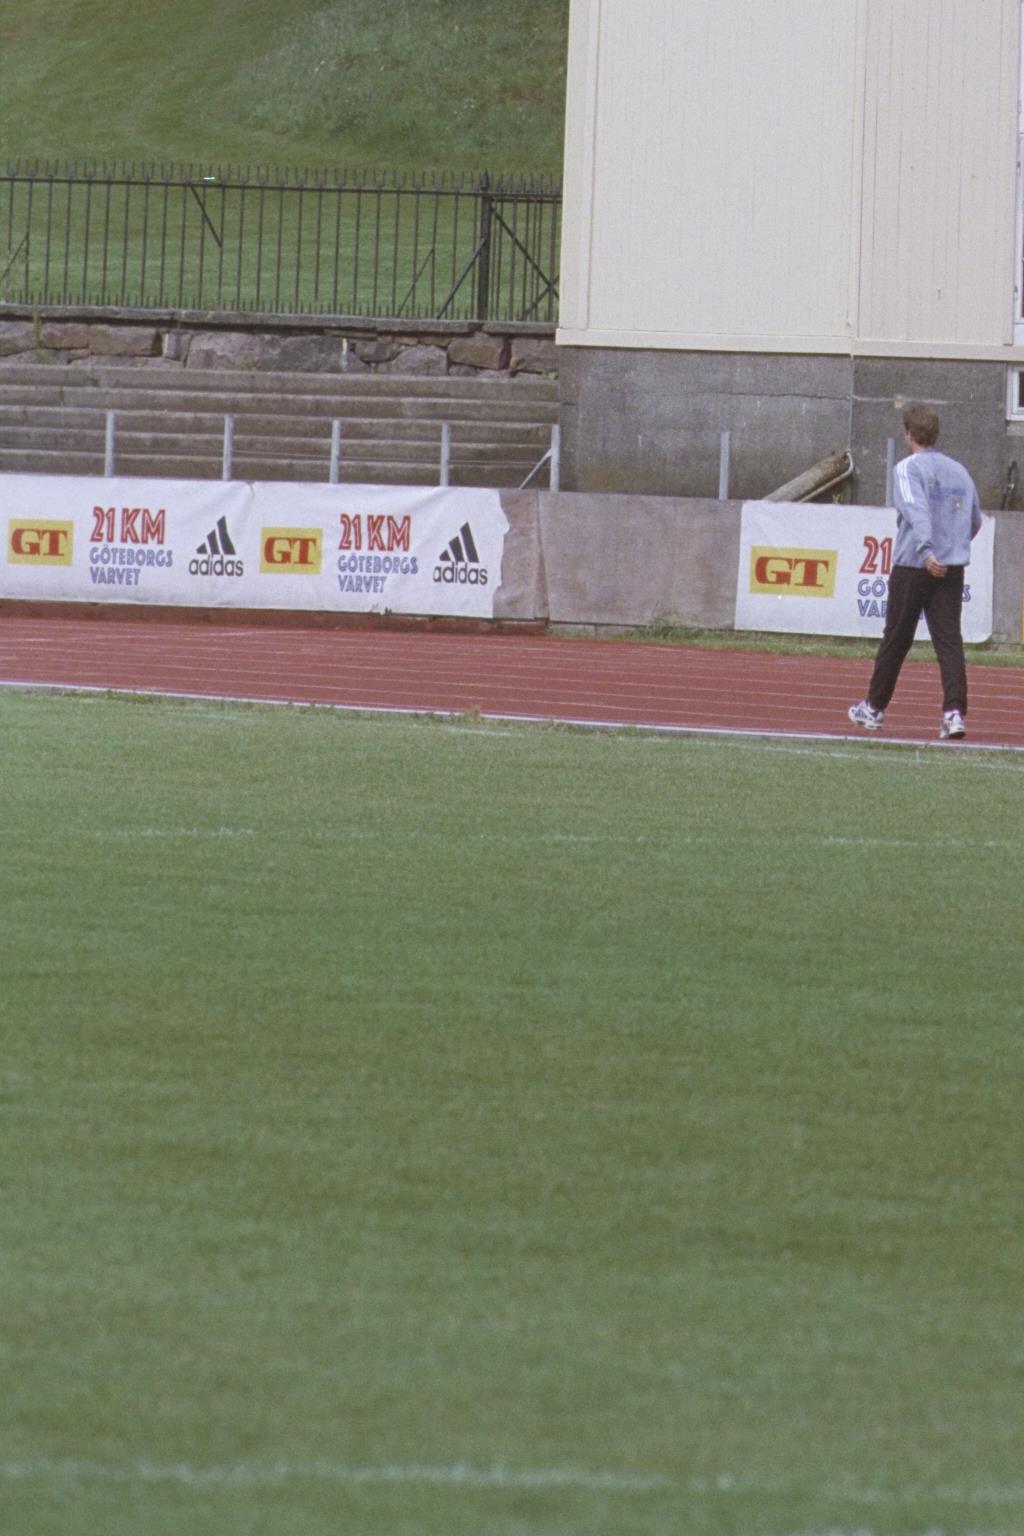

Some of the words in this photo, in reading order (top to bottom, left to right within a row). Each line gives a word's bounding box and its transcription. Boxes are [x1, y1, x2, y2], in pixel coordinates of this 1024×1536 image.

[90, 506, 116, 542] 21
[121, 508, 166, 544] KM
[338, 513, 363, 550] 21
[367, 515, 411, 551] KM
[11, 528, 68, 557] GT
[264, 536, 317, 564] GT
[89, 545, 173, 568] GÖTEBORGS
[189, 554, 244, 577] adidas
[337, 553, 418, 575] GÖTEBORGS
[859, 536, 893, 575] 21
[89, 566, 141, 586] VARVET
[338, 574, 386, 594] VARVET
[433, 562, 488, 585] adidas
[755, 556, 829, 587] GT
